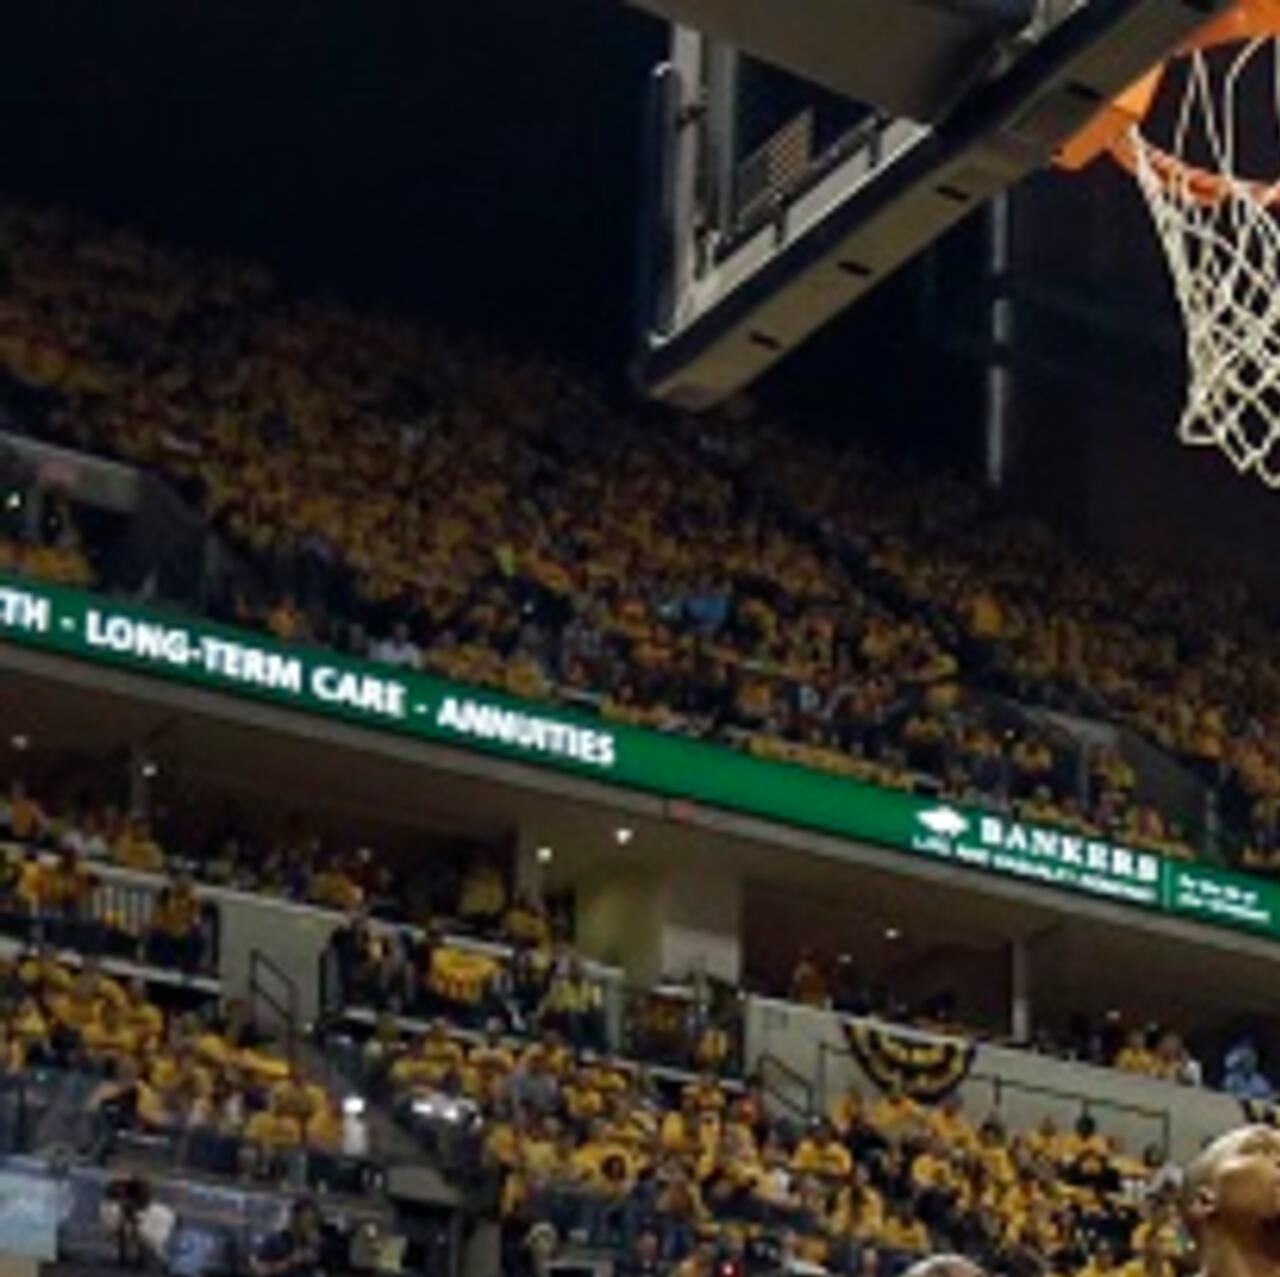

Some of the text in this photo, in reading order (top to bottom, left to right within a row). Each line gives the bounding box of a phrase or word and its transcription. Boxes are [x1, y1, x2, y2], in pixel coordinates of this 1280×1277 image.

[85, 609, 302, 693] LONG-TERM
[311, 665, 407, 718] CARE
[437, 697, 616, 767] ANNUITIES
[981, 816, 1160, 882] BANKERS
